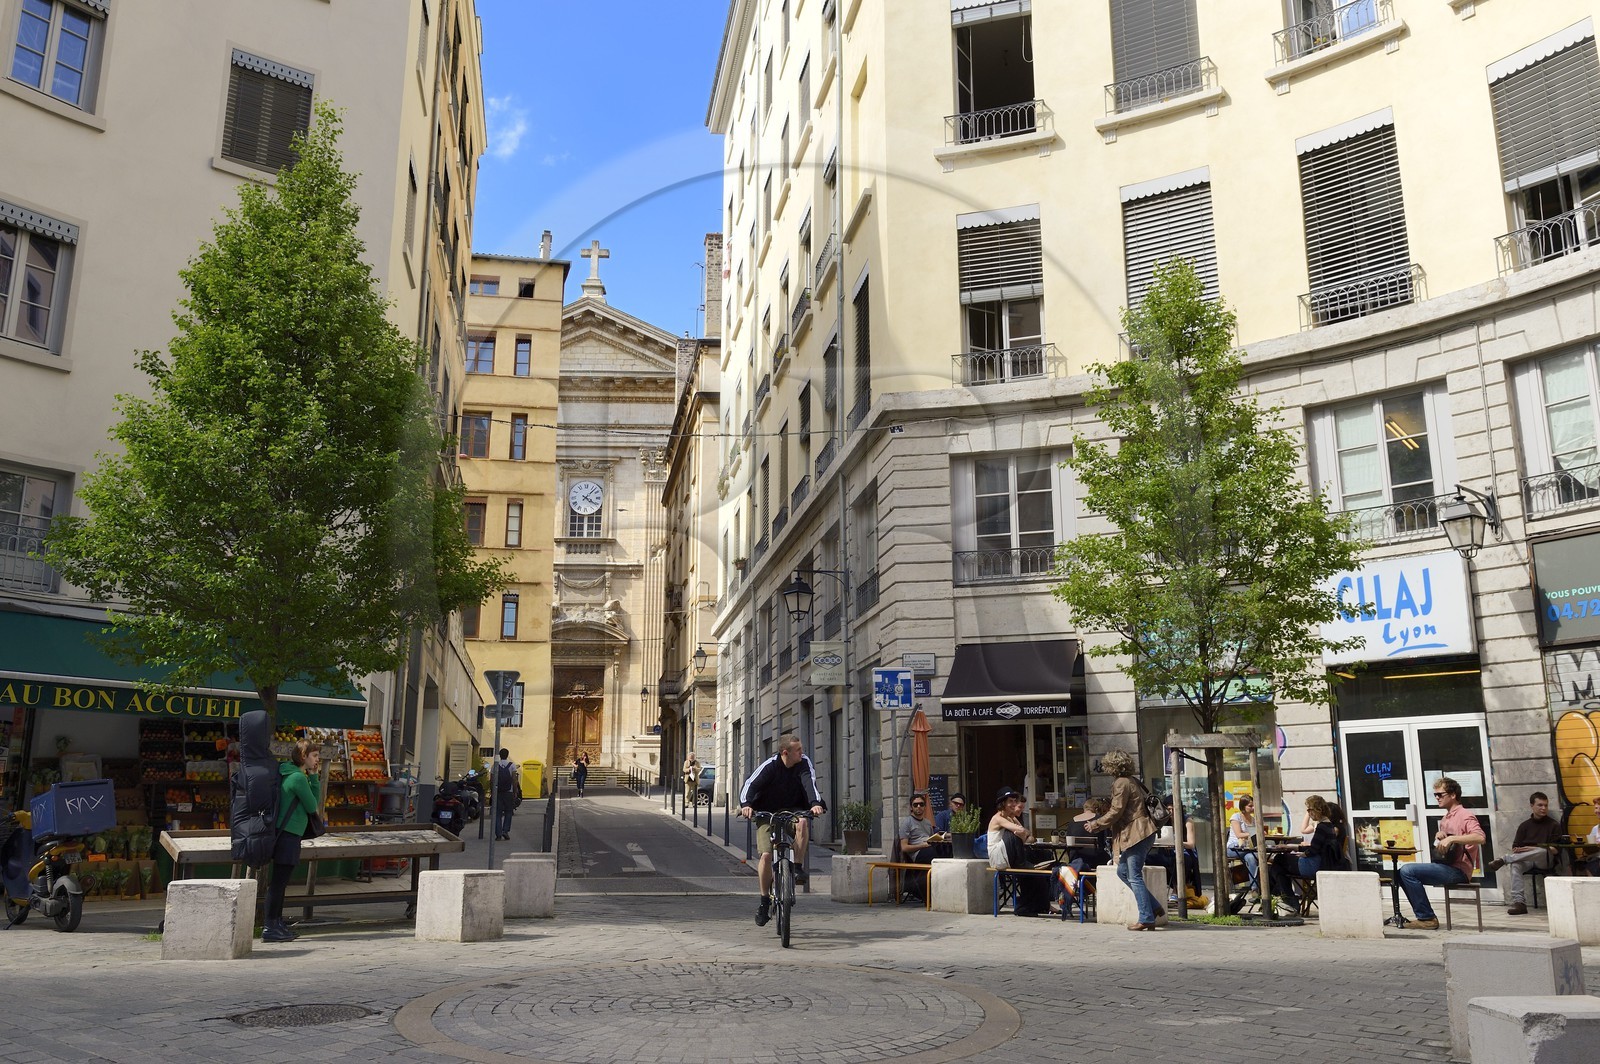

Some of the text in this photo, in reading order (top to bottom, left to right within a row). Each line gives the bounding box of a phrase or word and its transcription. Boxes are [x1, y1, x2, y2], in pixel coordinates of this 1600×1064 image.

[1337, 568, 1433, 623] CLLAJ
[1545, 590, 1570, 599] VOUS
[1547, 598, 1600, 622] 04.72
[1382, 622, 1437, 646] Lyon
[0, 683, 241, 718] AU BON ACCUEIL
[954, 708, 970, 716] BOÎTE
[972, 708, 977, 716] À
[978, 707, 993, 716] CAFÉ
[1023, 705, 1067, 715] TORRÉFACTION
[1365, 762, 1392, 773] CLLAJ
